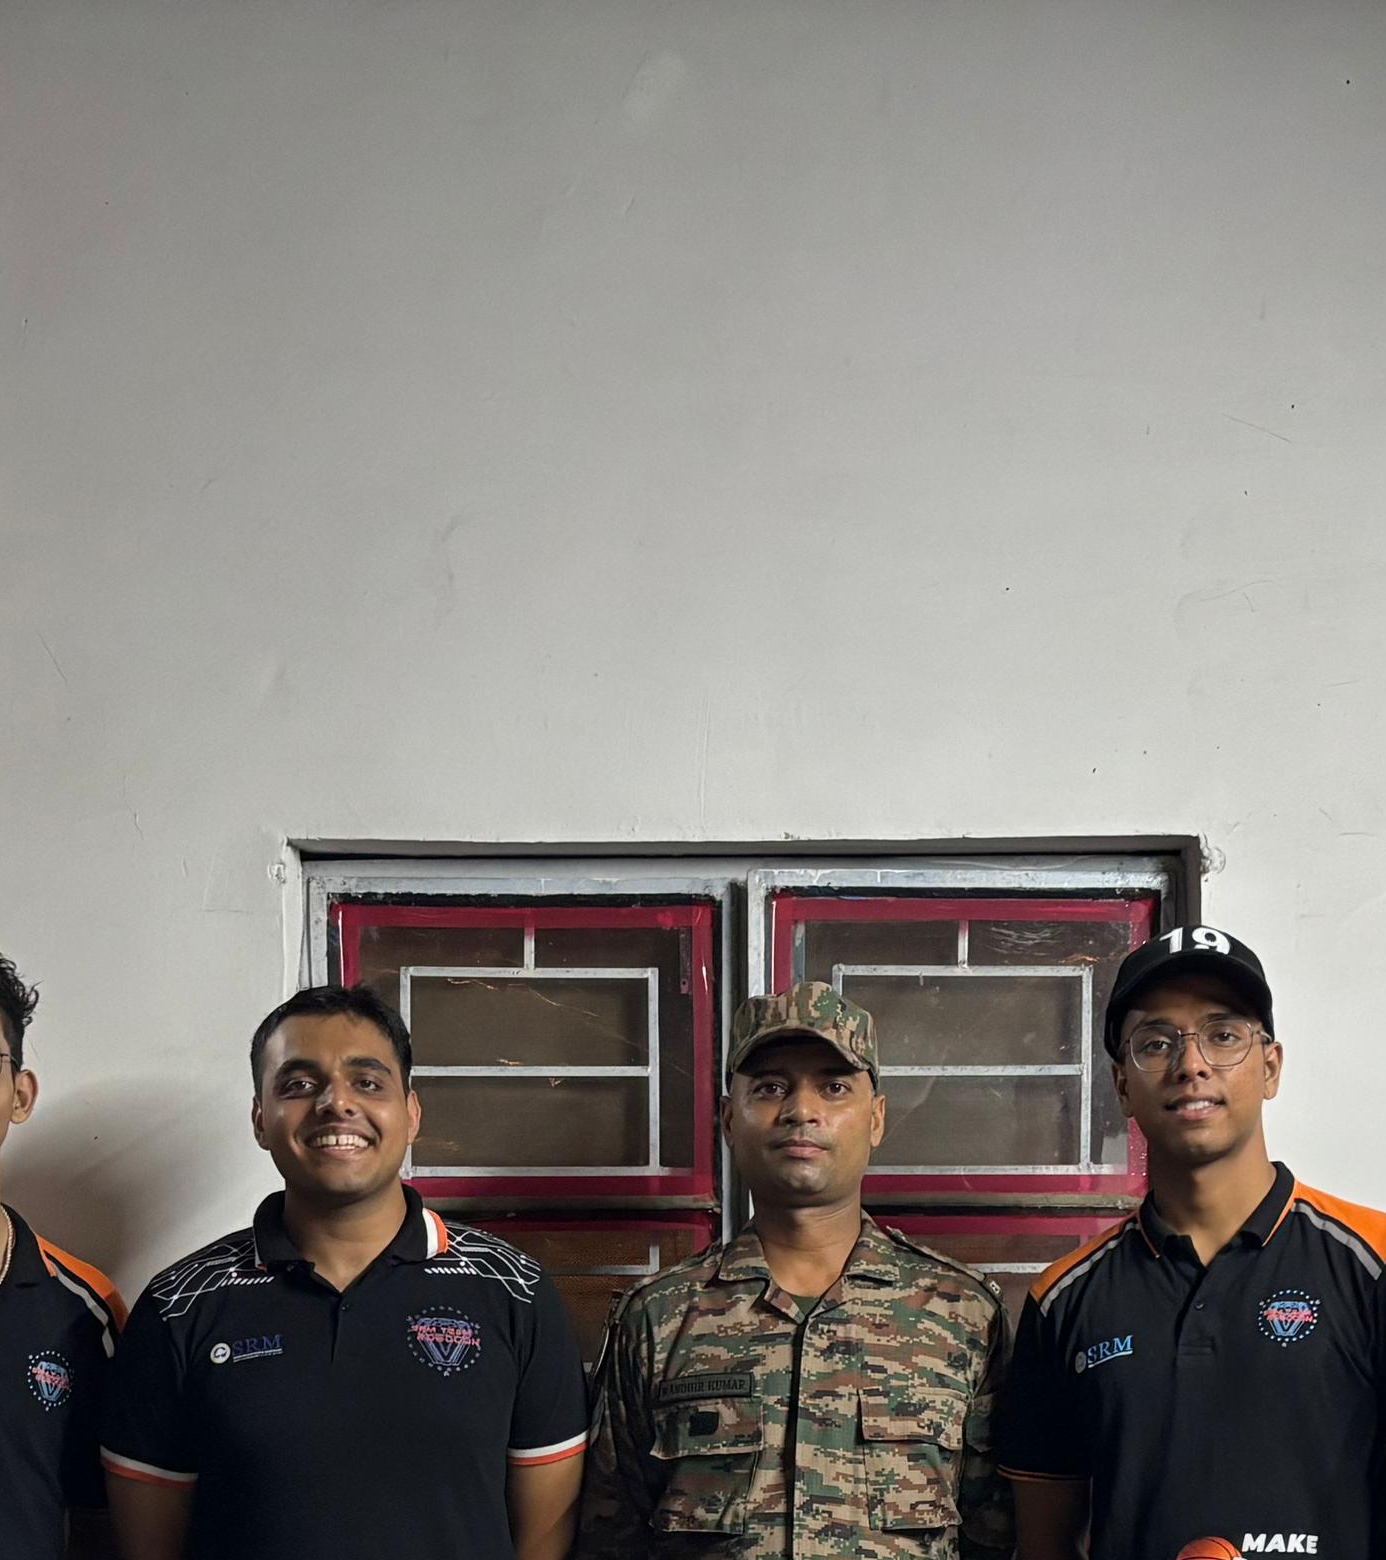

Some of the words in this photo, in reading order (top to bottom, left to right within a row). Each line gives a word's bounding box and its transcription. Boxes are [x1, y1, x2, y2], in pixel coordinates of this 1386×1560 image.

[1159, 927, 1231, 955] 19
[233, 1334, 282, 1354] SRM
[1087, 1335, 1134, 1363] SRM
[1242, 1533, 1319, 1554] MAKE
